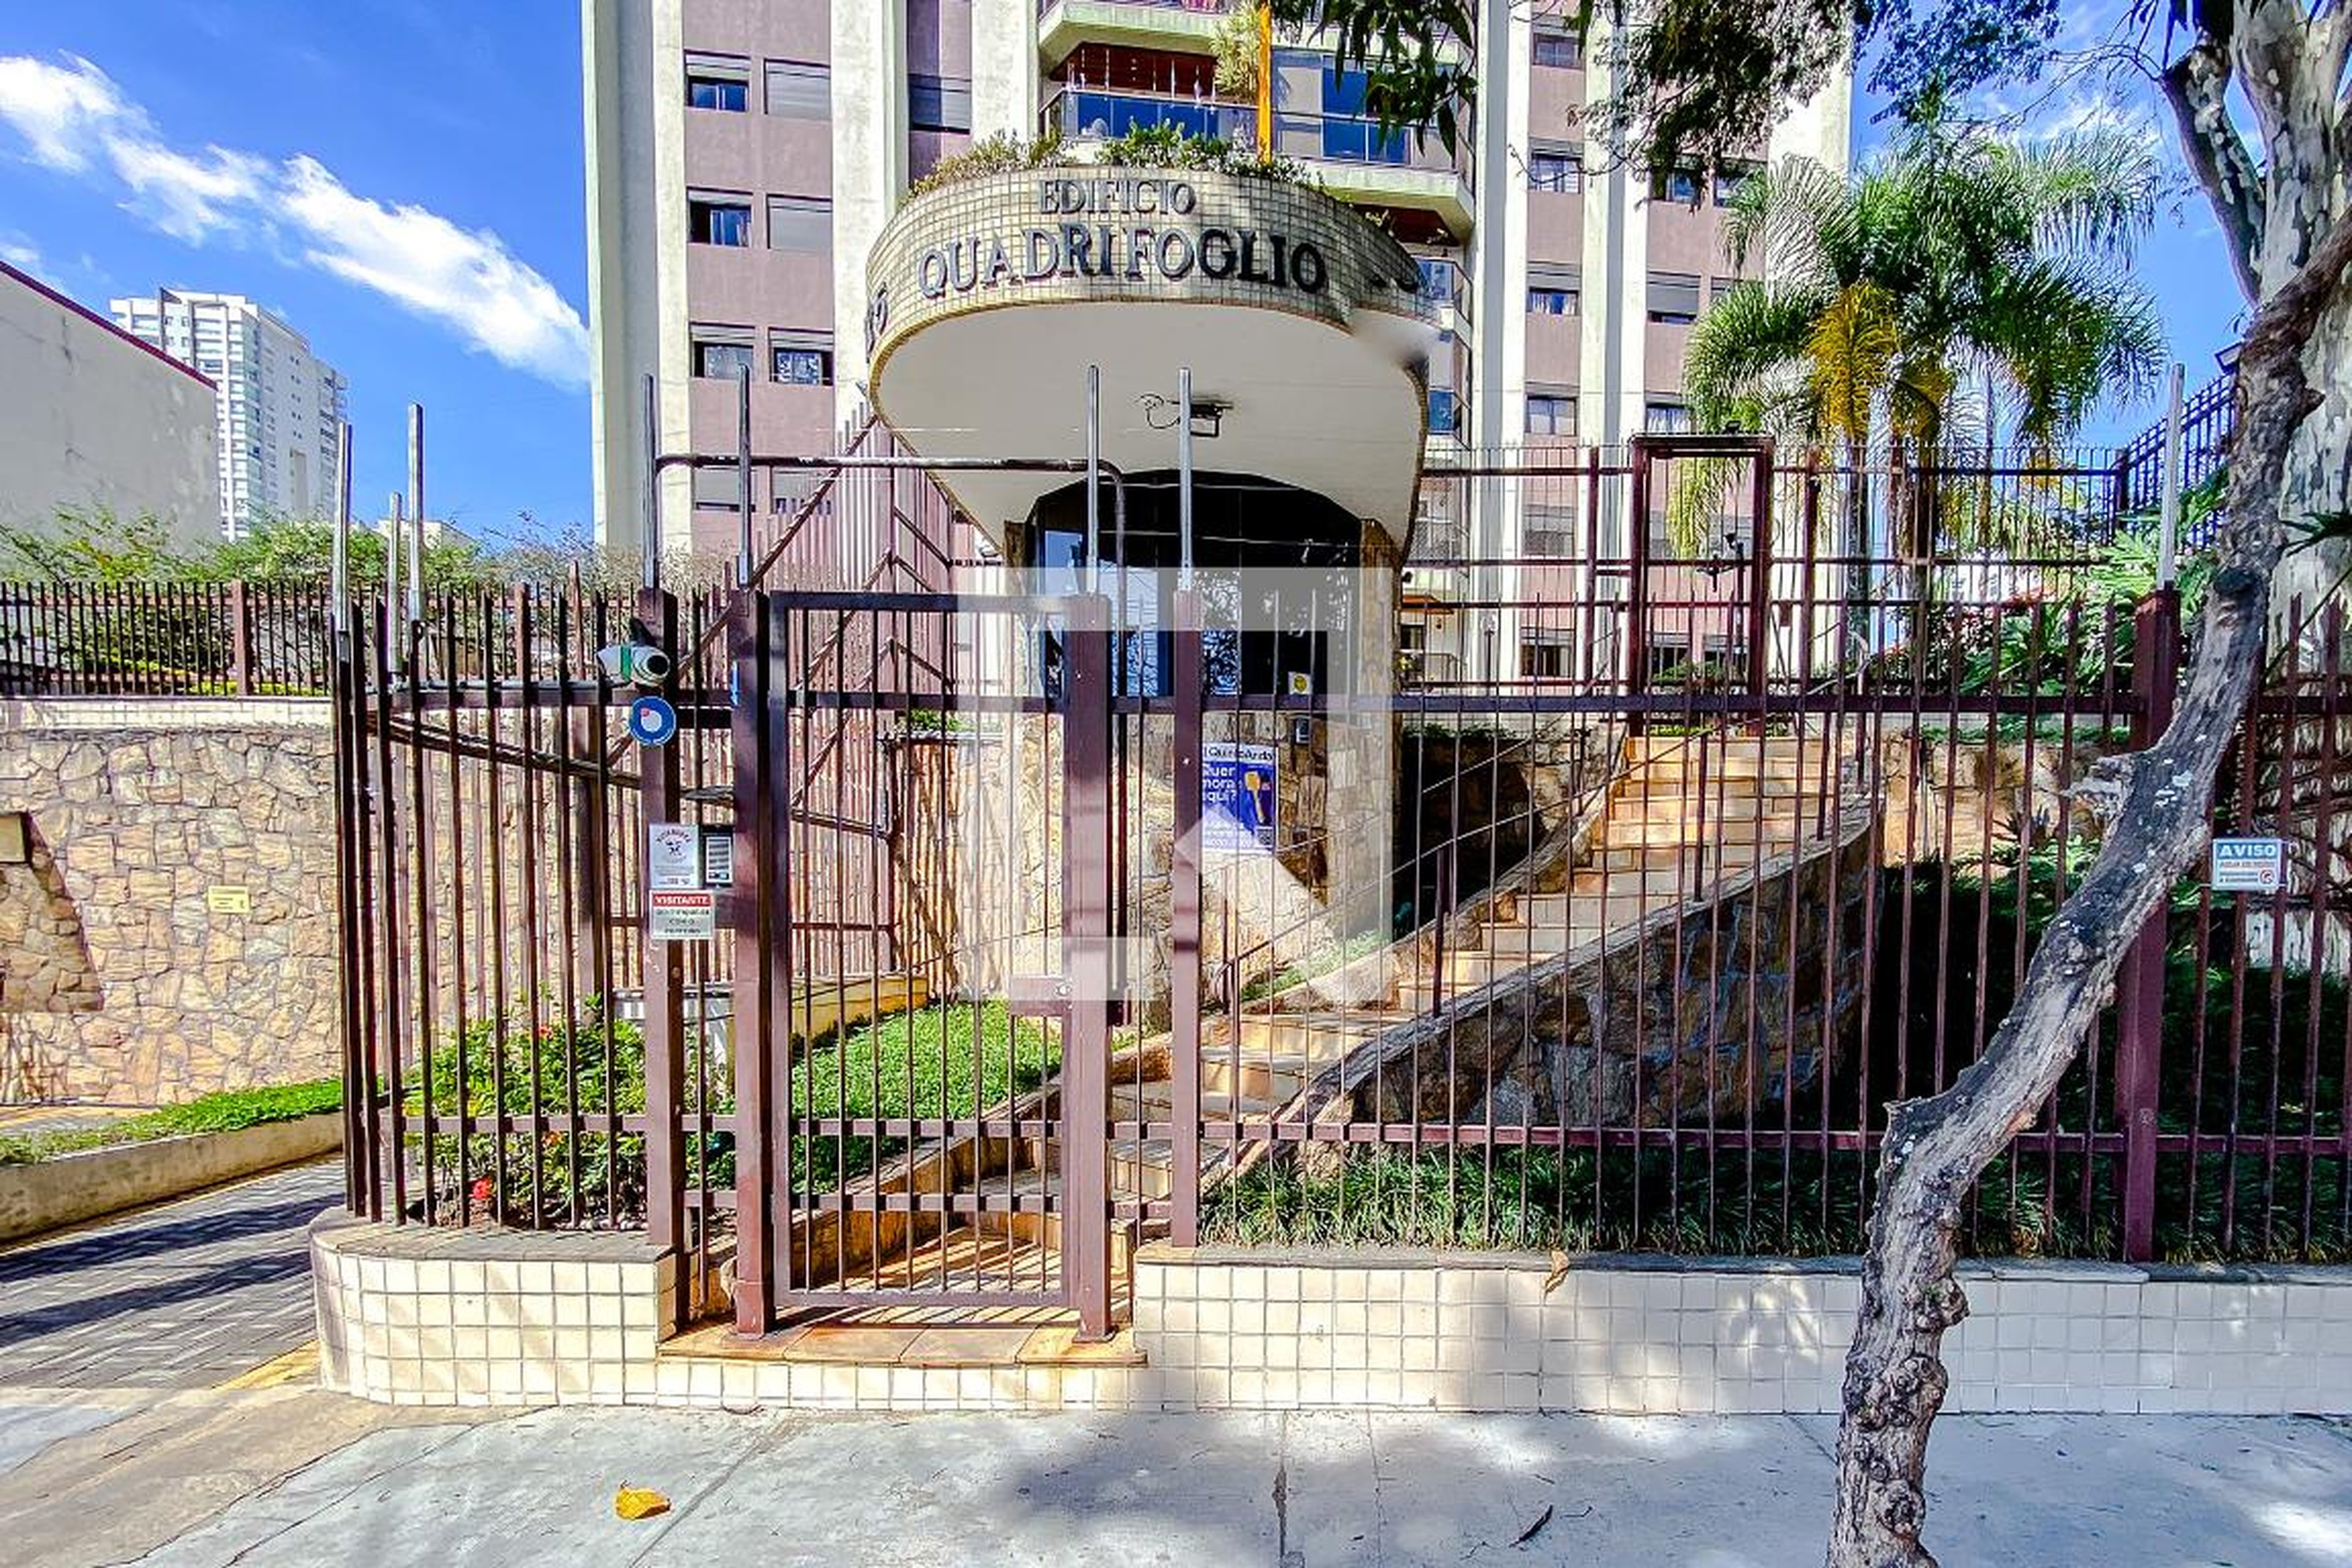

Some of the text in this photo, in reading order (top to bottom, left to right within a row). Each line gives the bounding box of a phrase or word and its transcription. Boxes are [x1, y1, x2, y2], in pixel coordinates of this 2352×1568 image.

[1039, 179, 1196, 215] EDIFICIO
[918, 222, 1330, 299] QUADRIFOGLIO
[1202, 790, 1237, 803] qui?
[2219, 845, 2276, 857] AVISO
[655, 895, 709, 905] VISITANTE
